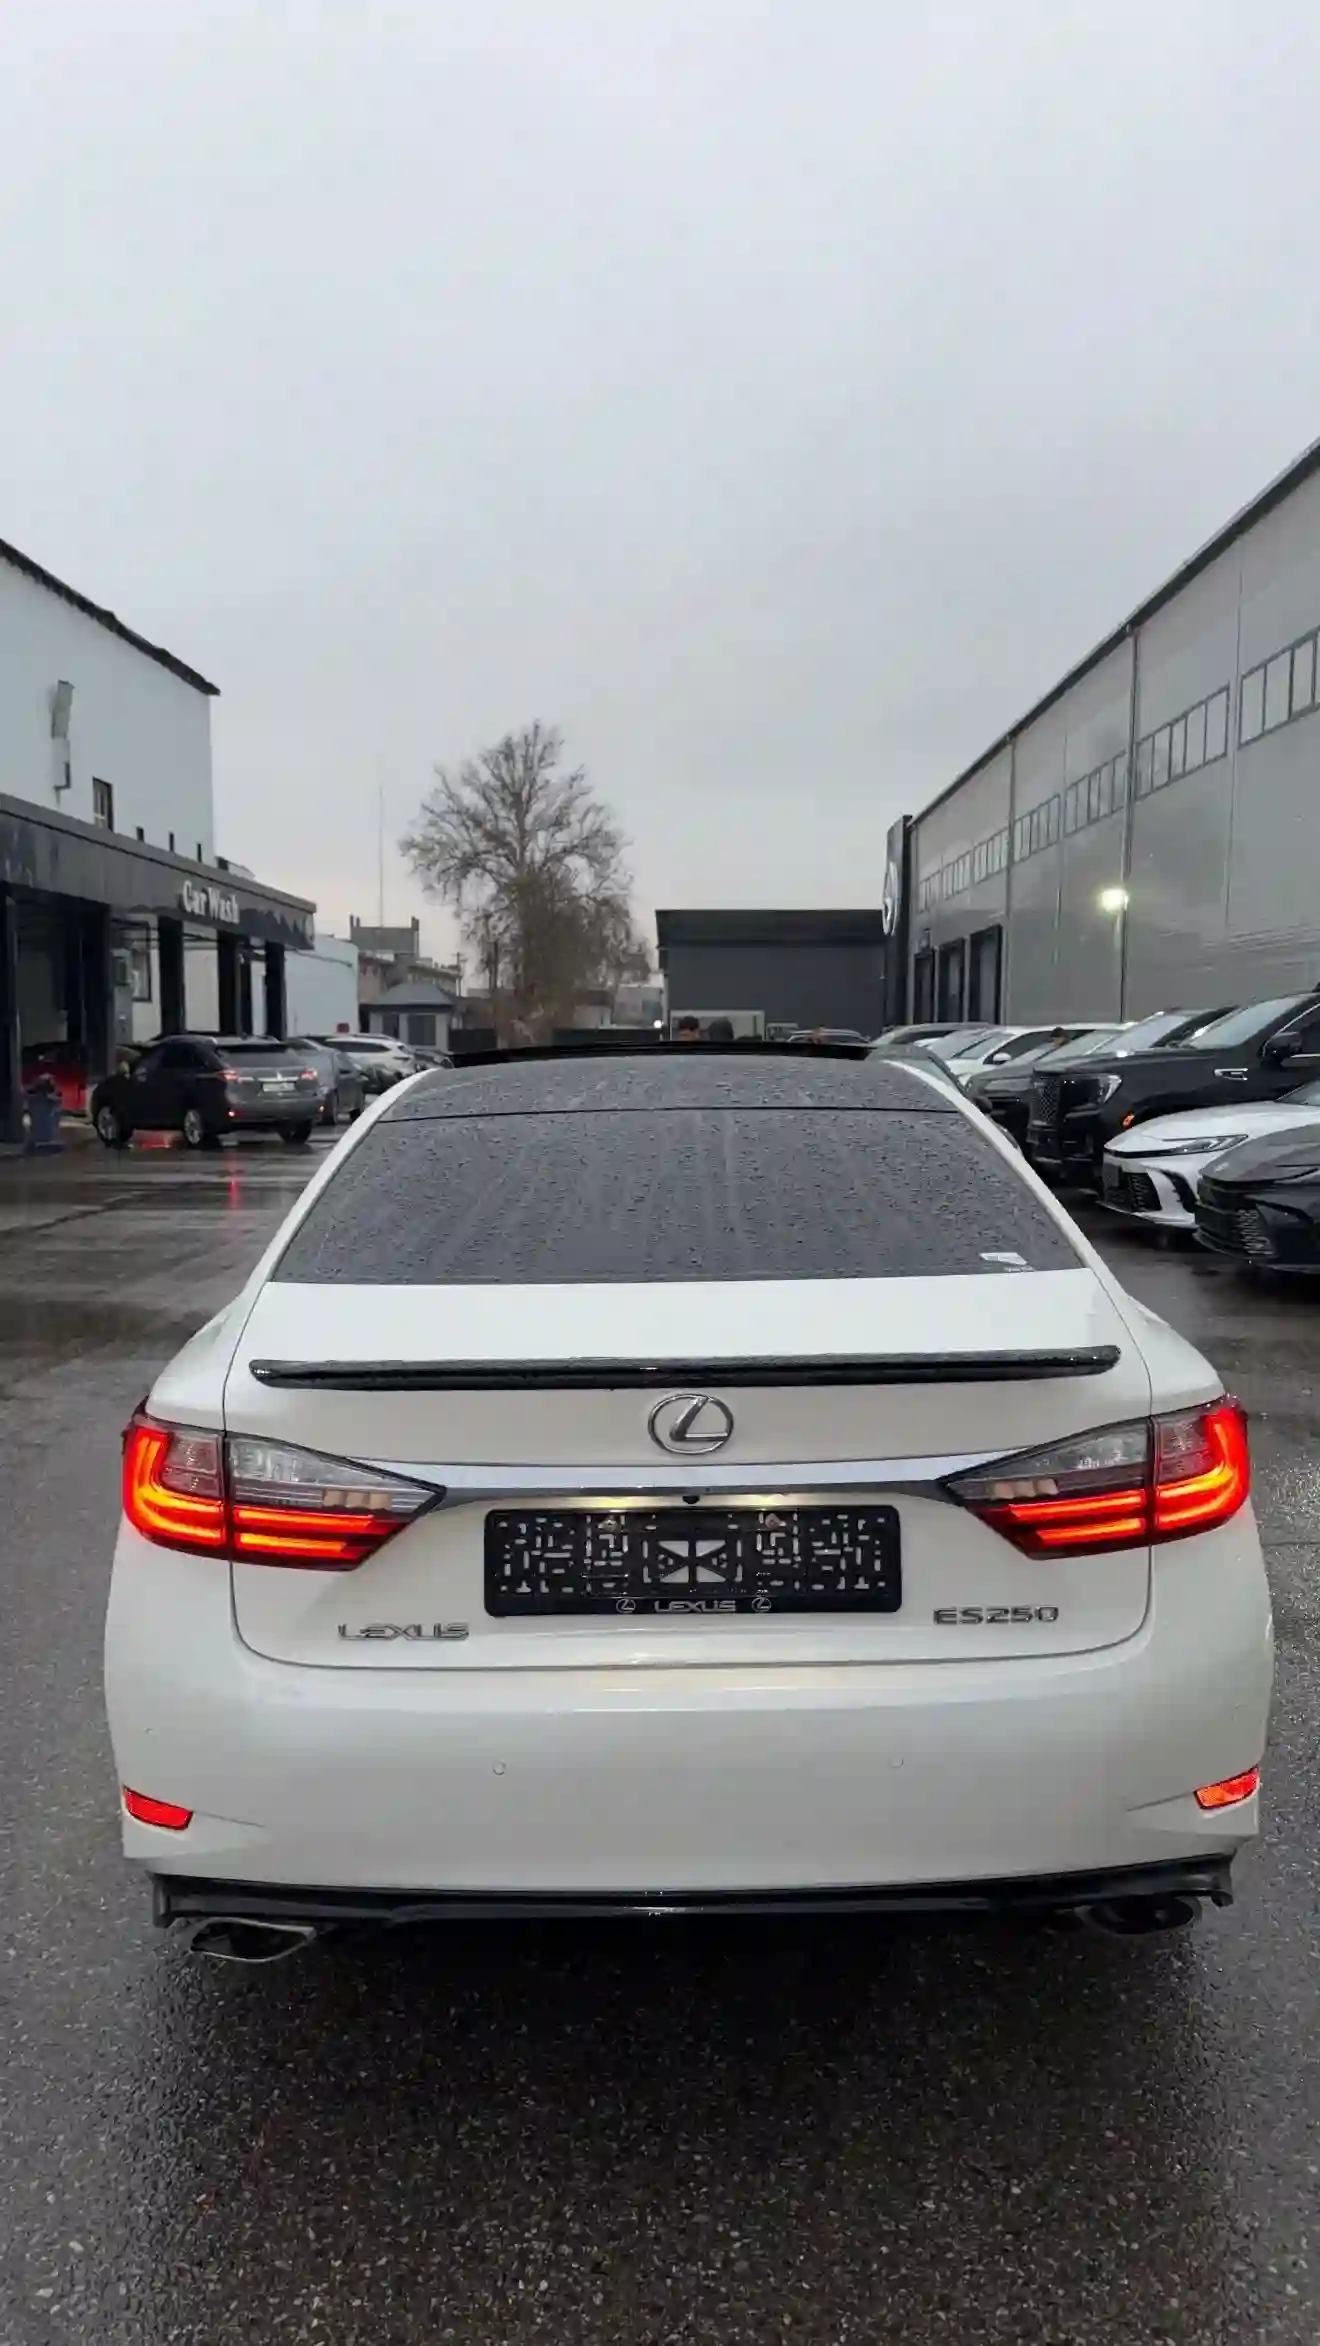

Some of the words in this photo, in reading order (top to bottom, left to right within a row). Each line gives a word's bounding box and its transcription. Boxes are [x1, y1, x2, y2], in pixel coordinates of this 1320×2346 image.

[183, 880, 207, 916] Car
[208, 887, 239, 924] Wash
[654, 1600, 737, 1613] LEXUS
[933, 1605, 1059, 1625] ES250
[338, 1622, 470, 1641] LEXUS
